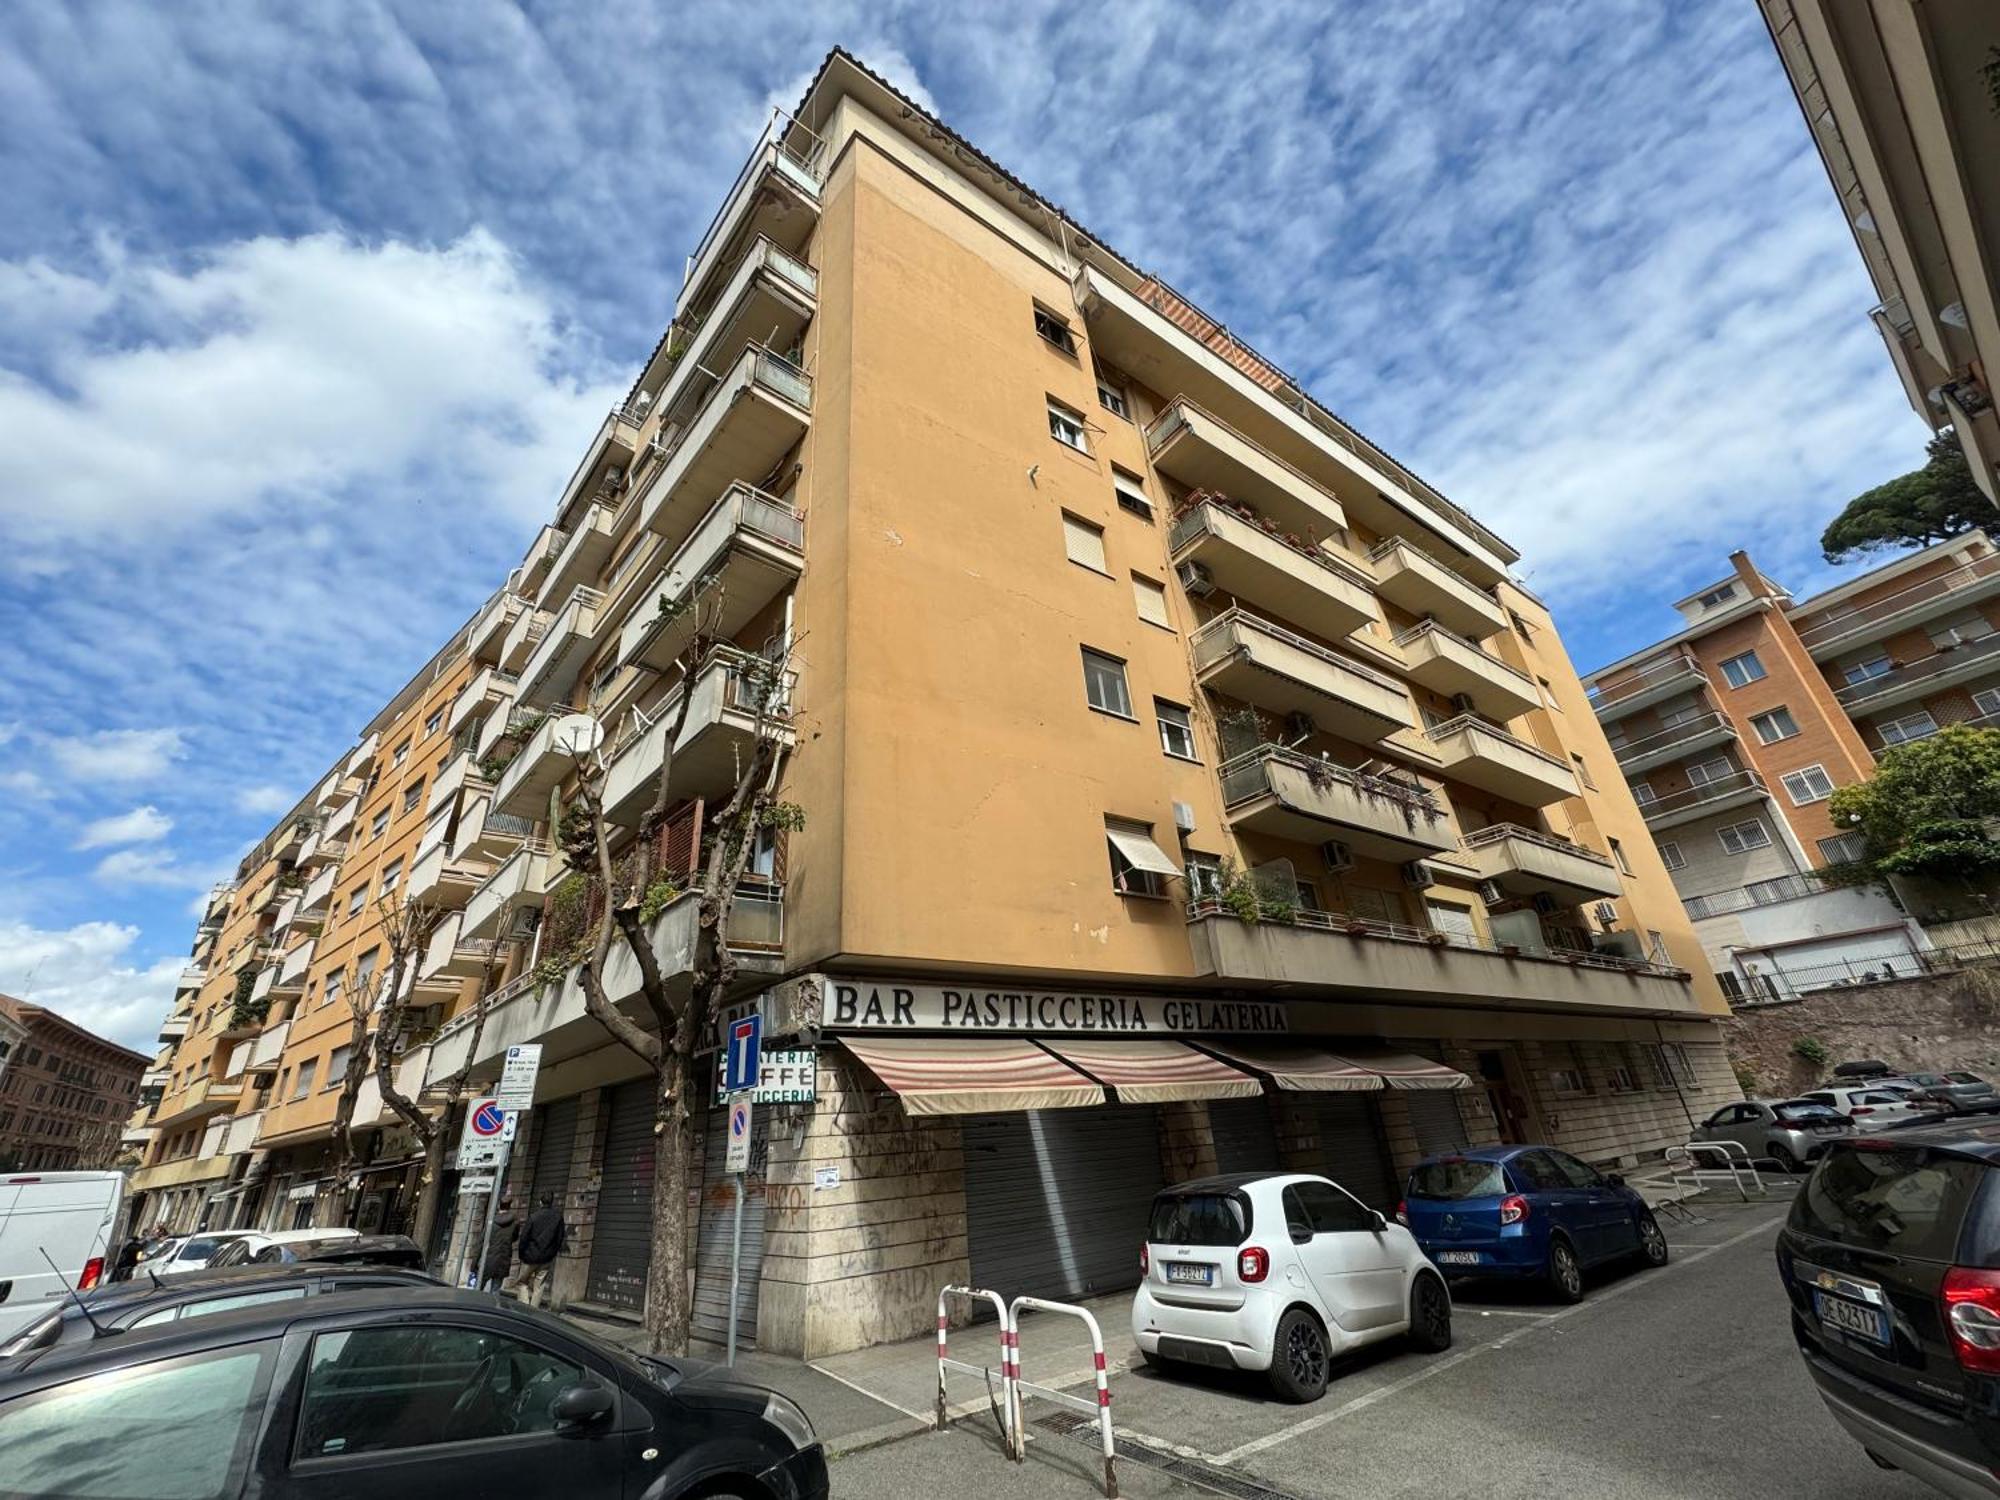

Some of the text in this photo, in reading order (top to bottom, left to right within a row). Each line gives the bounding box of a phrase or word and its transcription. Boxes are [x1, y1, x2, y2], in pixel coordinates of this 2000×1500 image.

[833, 986, 1287, 1031] BAR PASTICCERIA GELATERIA
